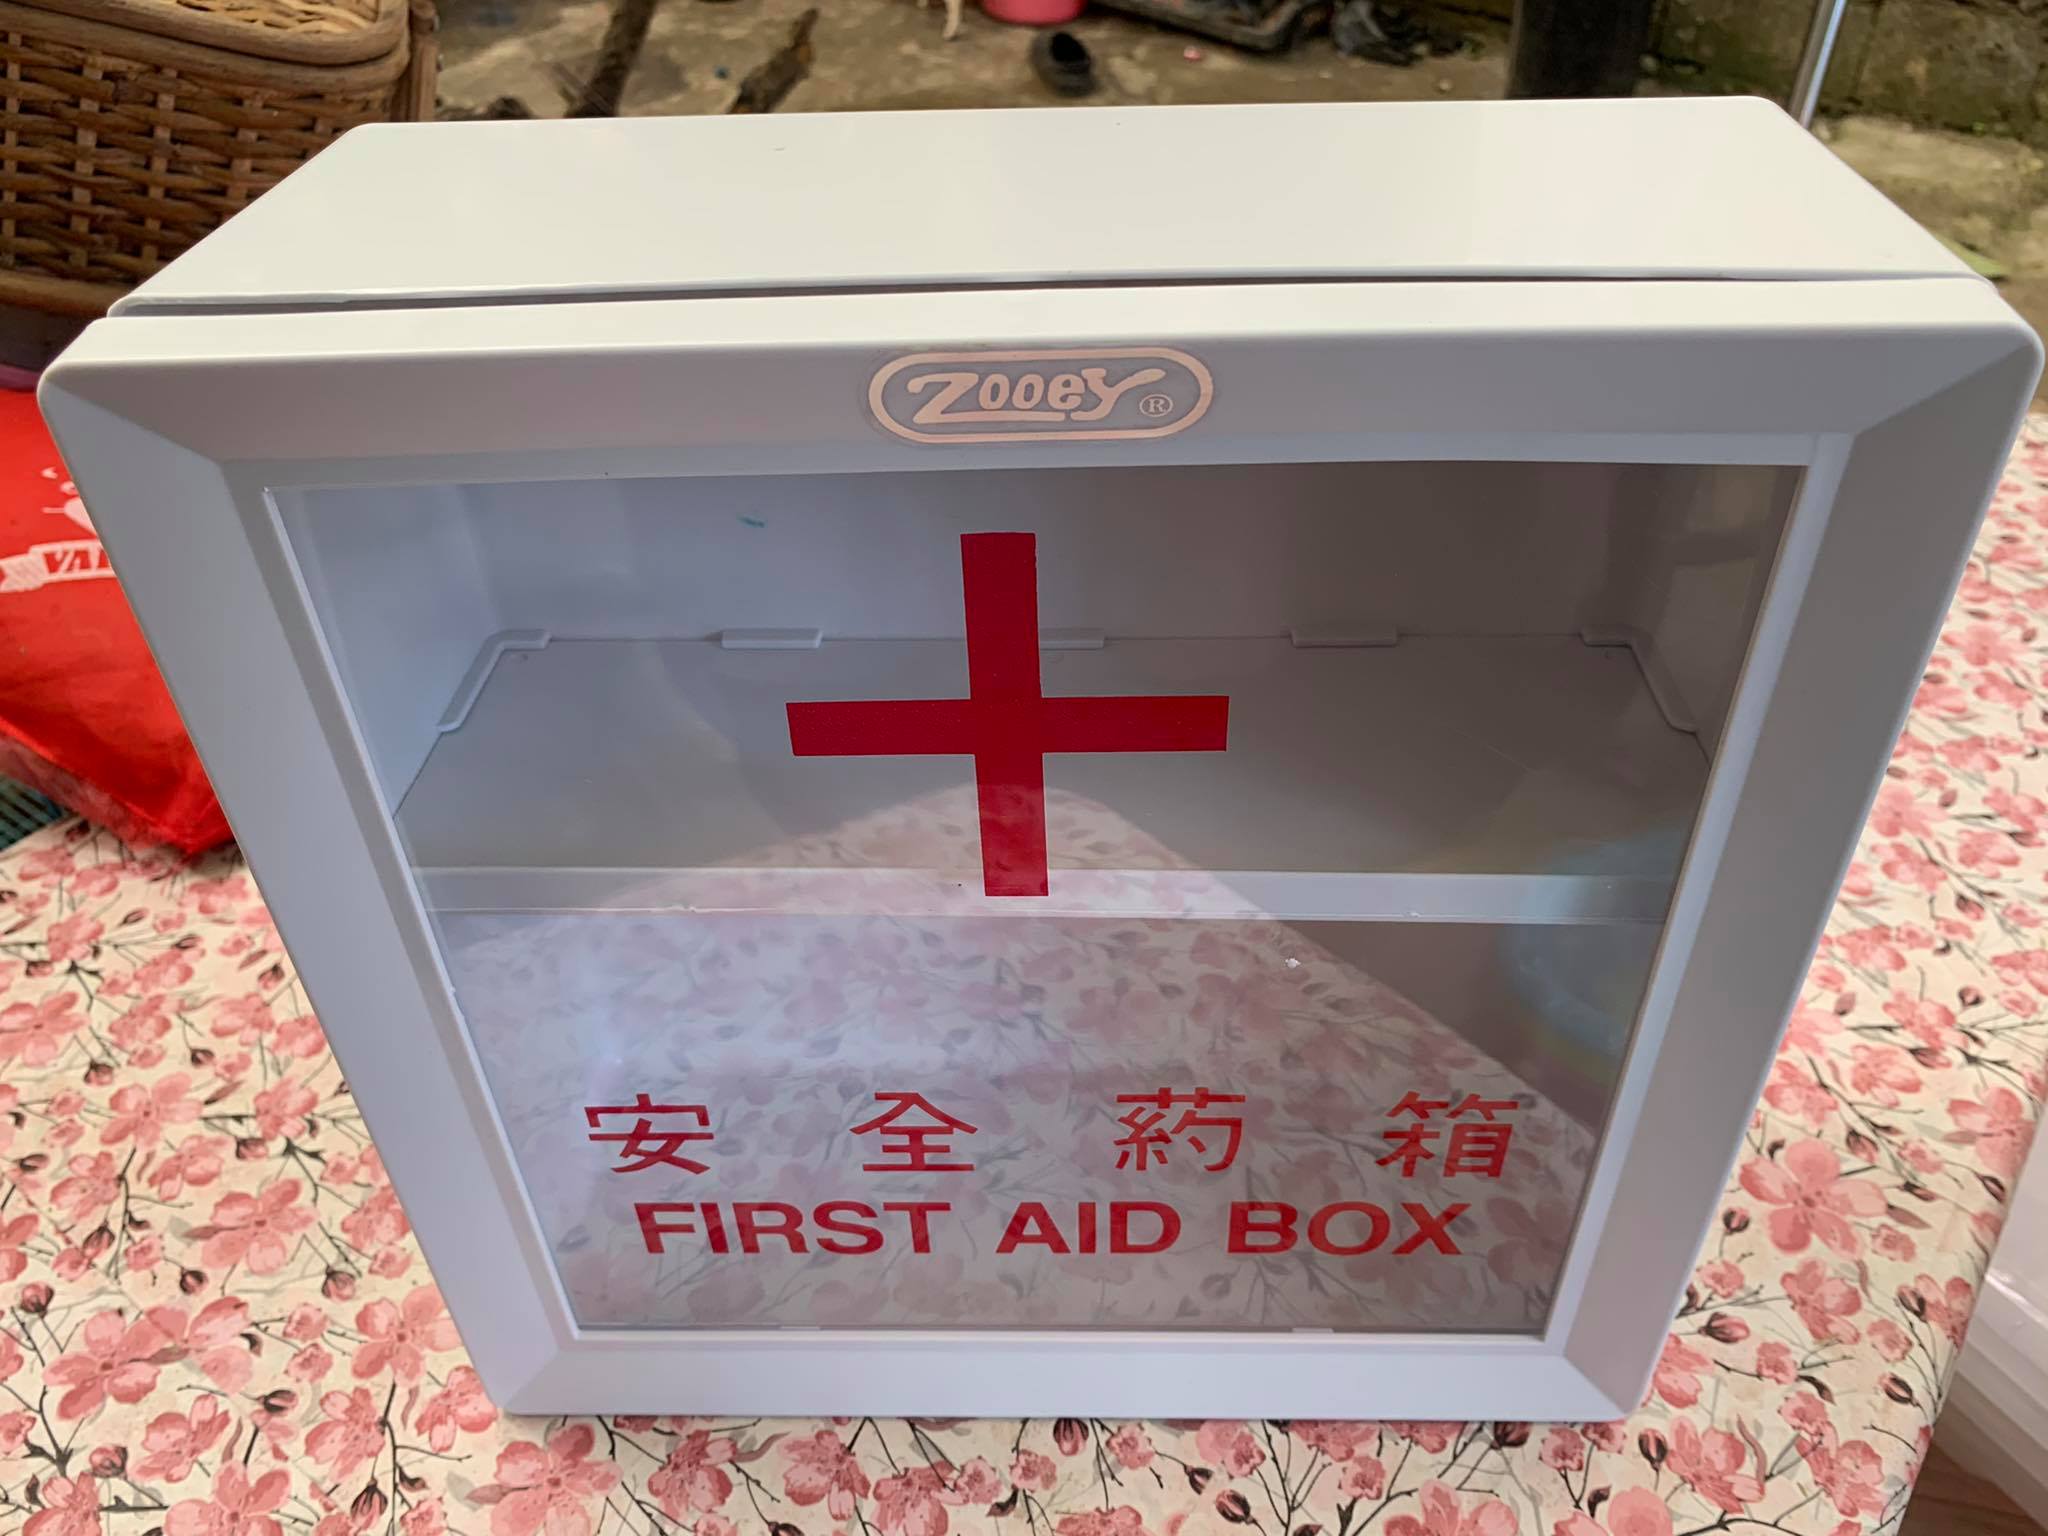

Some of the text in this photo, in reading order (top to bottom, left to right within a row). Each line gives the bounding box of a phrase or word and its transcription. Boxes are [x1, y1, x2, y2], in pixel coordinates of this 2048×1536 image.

[907, 368, 1166, 424] Zooey
[634, 1201, 1471, 1256] FIRST AID BOX
